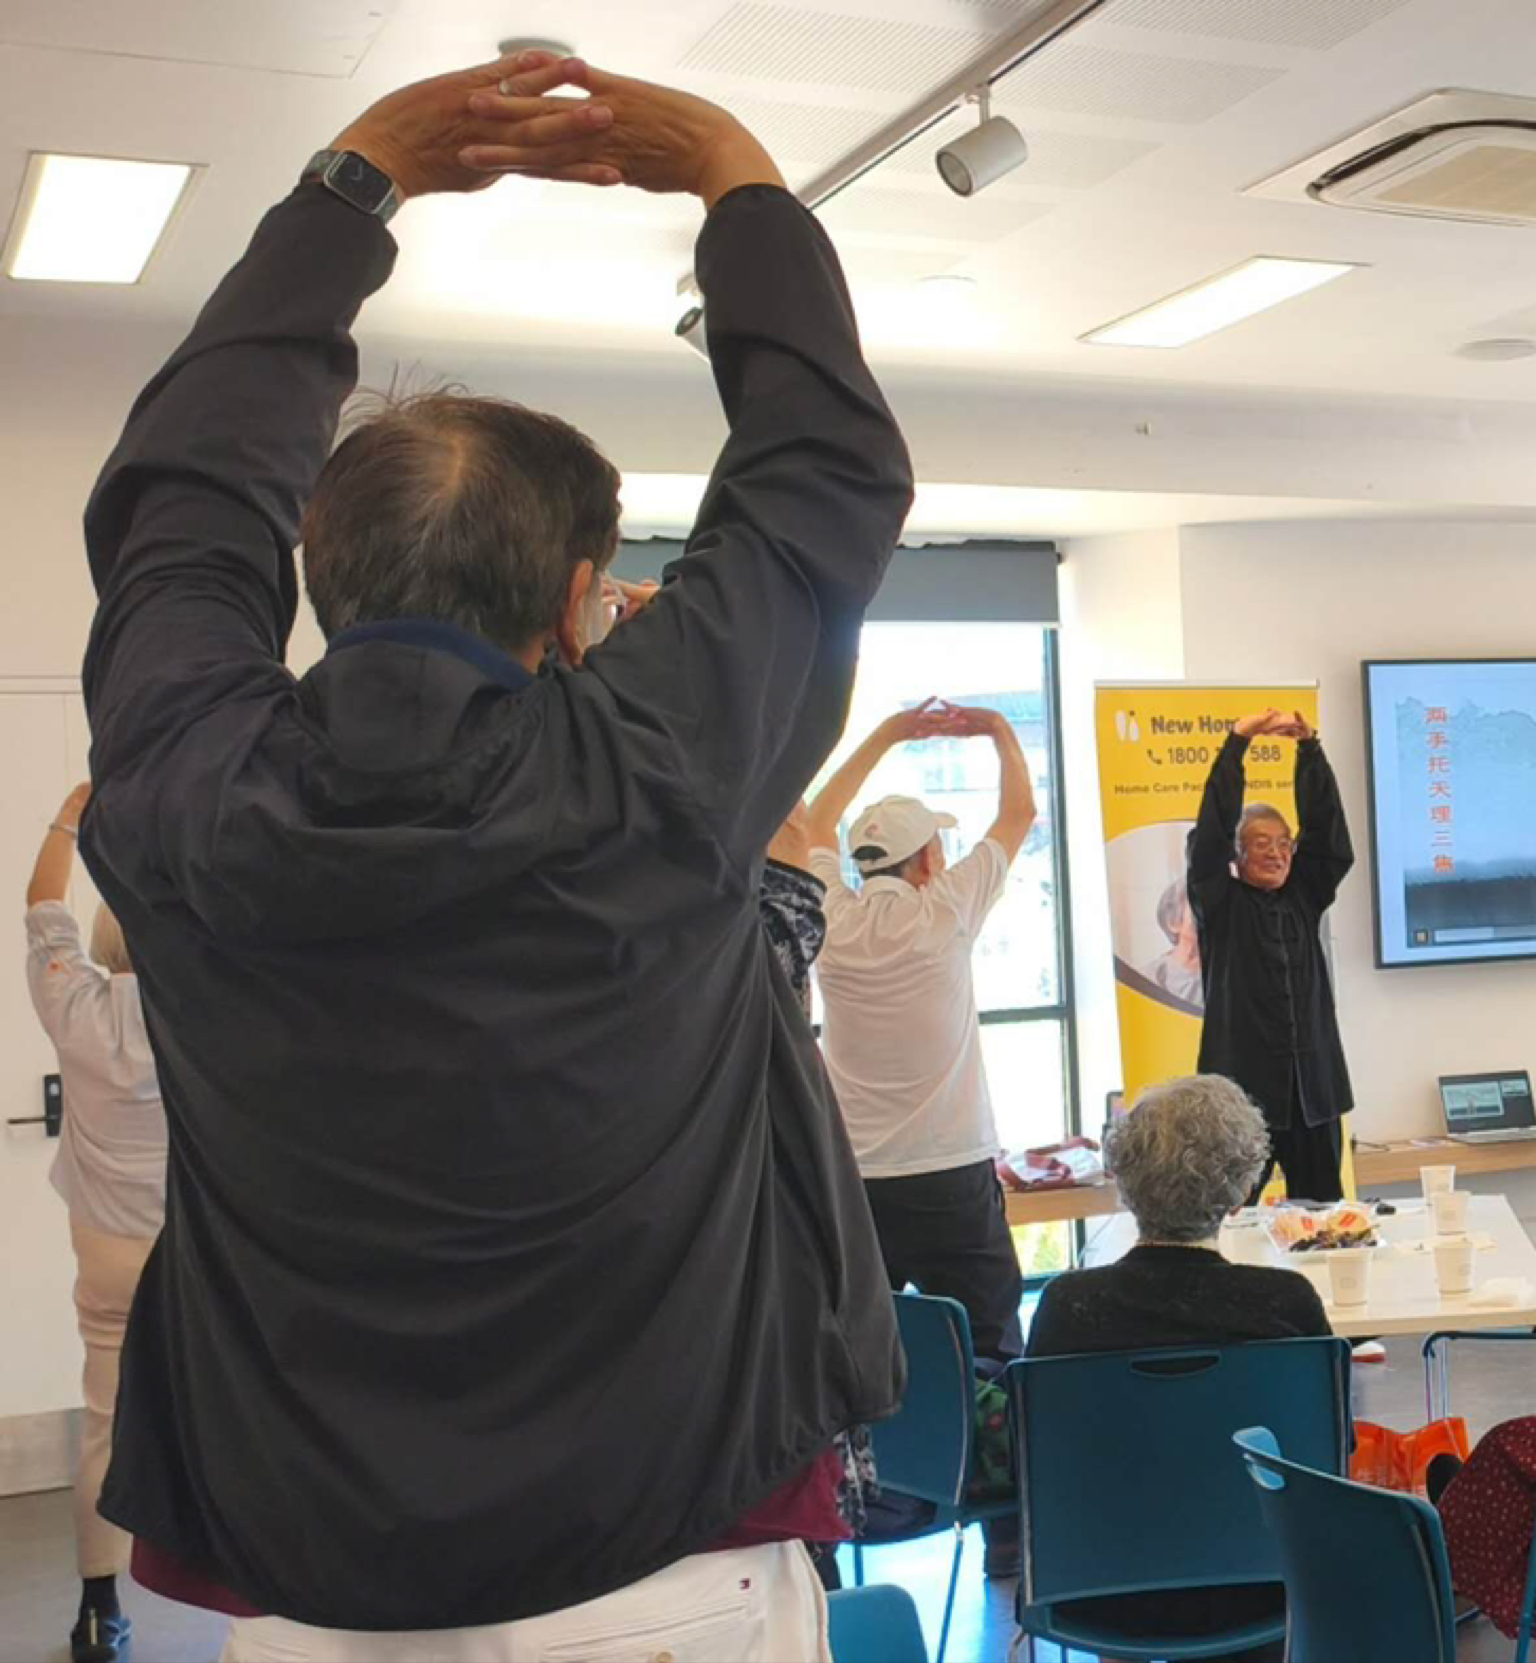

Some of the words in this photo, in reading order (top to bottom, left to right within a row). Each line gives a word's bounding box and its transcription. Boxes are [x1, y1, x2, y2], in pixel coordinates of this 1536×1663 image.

[1151, 716, 1193, 735] New
[1198, 716, 1239, 735] Hom
[1168, 747, 1209, 764] 1800
[1251, 745, 1282, 762] 588
[1114, 784, 1149, 795] Home
[1153, 783, 1179, 794] Care
